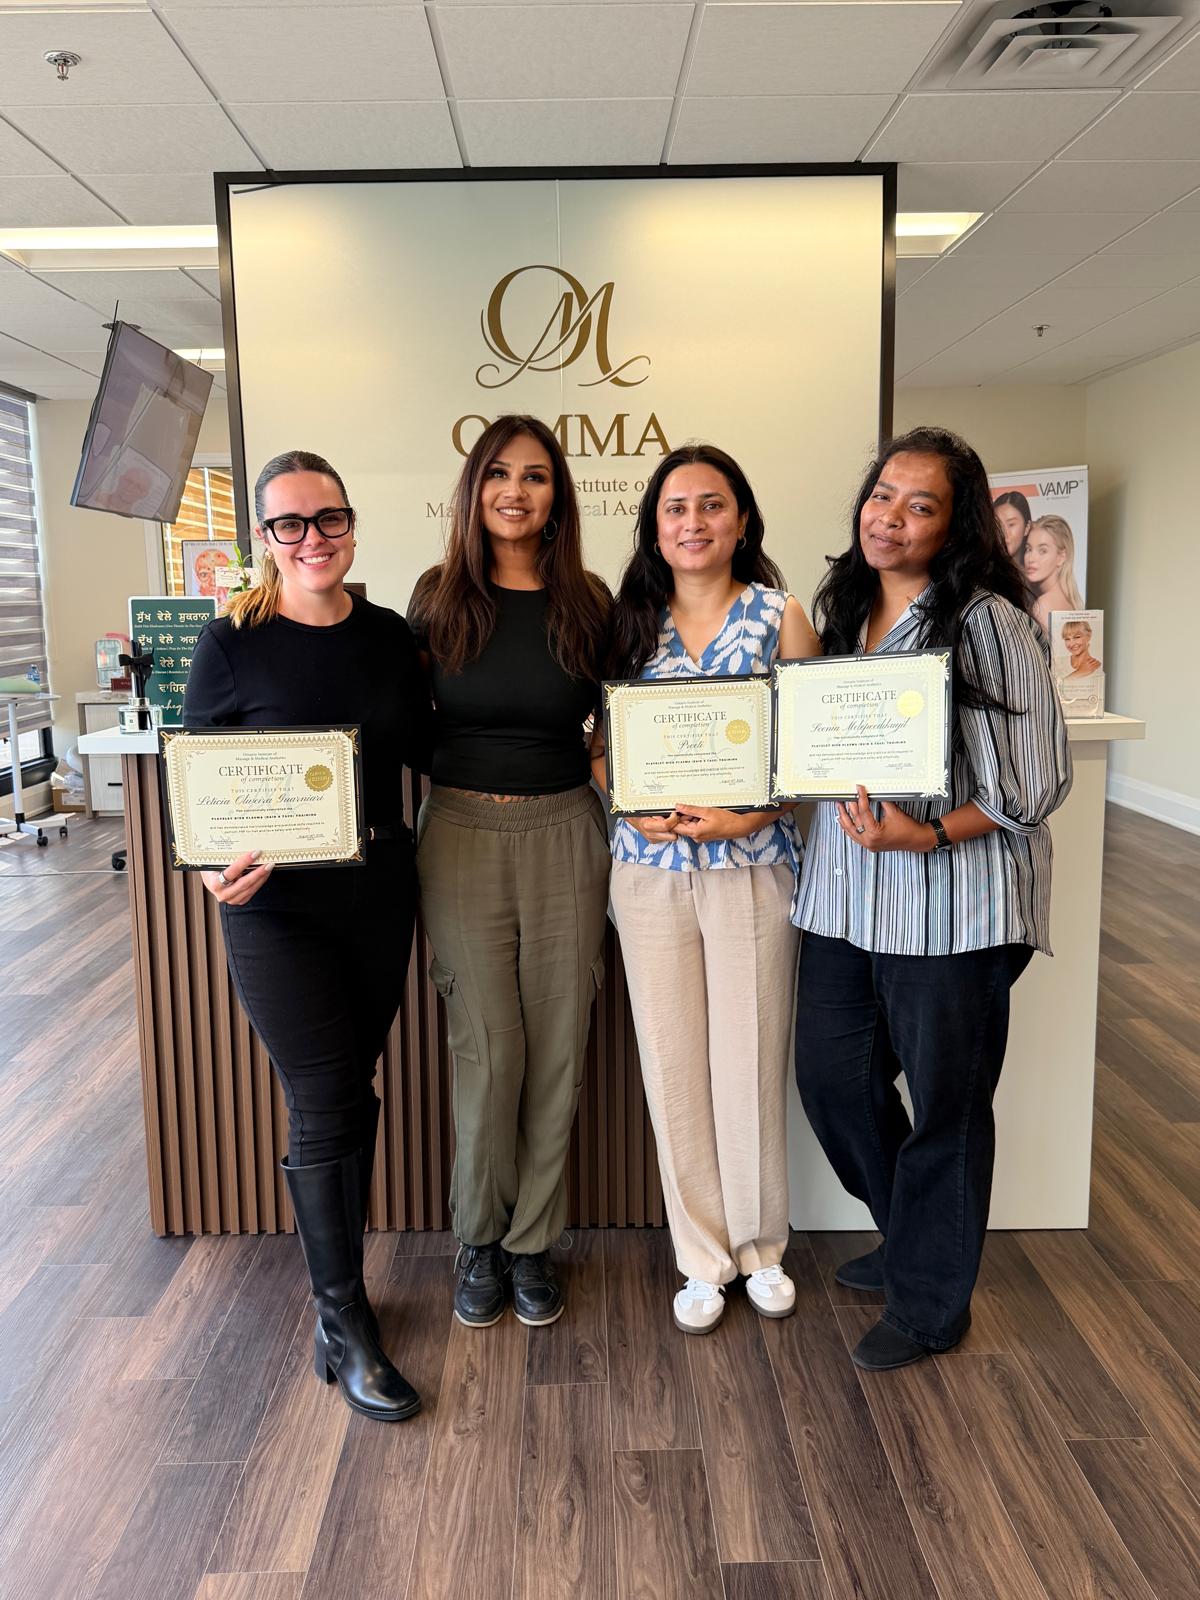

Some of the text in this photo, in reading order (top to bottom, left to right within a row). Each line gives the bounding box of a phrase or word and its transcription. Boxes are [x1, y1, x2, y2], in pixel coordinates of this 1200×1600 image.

[574, 478, 628, 492] stitute
[1039, 480, 1079, 496] VAMP
[821, 690, 897, 704] CERTIFICATE
[653, 711, 727, 724] CERTIFICATE
[218, 764, 304, 777] CERTIFICATE
